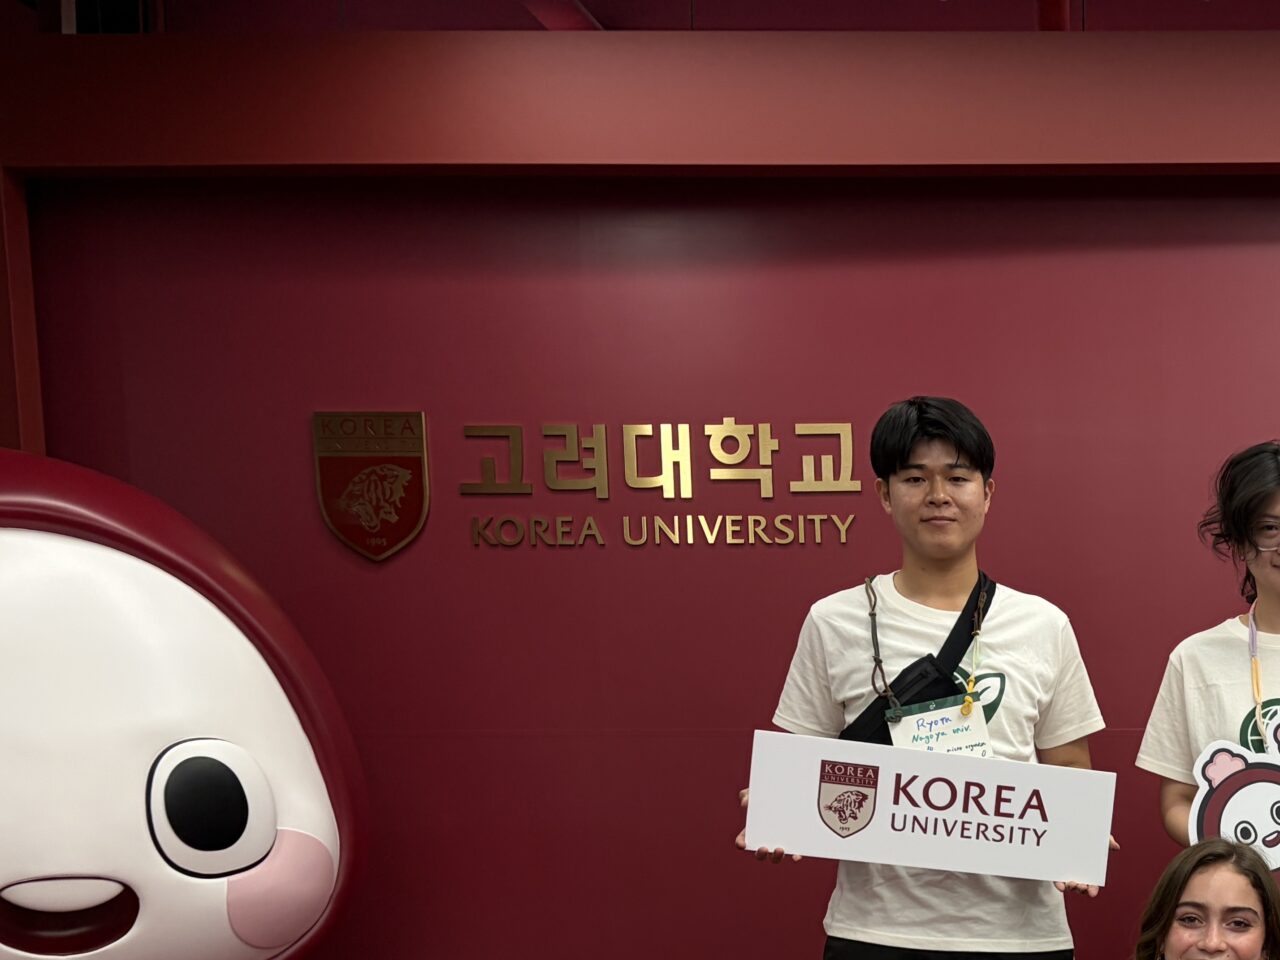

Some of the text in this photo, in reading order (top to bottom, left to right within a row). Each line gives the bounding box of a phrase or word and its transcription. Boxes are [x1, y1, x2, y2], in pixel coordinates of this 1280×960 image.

[320, 418, 416, 436] KOREA
[460, 417, 862, 499] 고려대학교
[471, 514, 855, 545] KOREA UNIVERSITY
[824, 775, 874, 786] UNIVERSITY
[825, 764, 875, 779] KOREA
[892, 773, 1049, 823] KOREA
[890, 813, 1048, 847] UNIVERSITY
